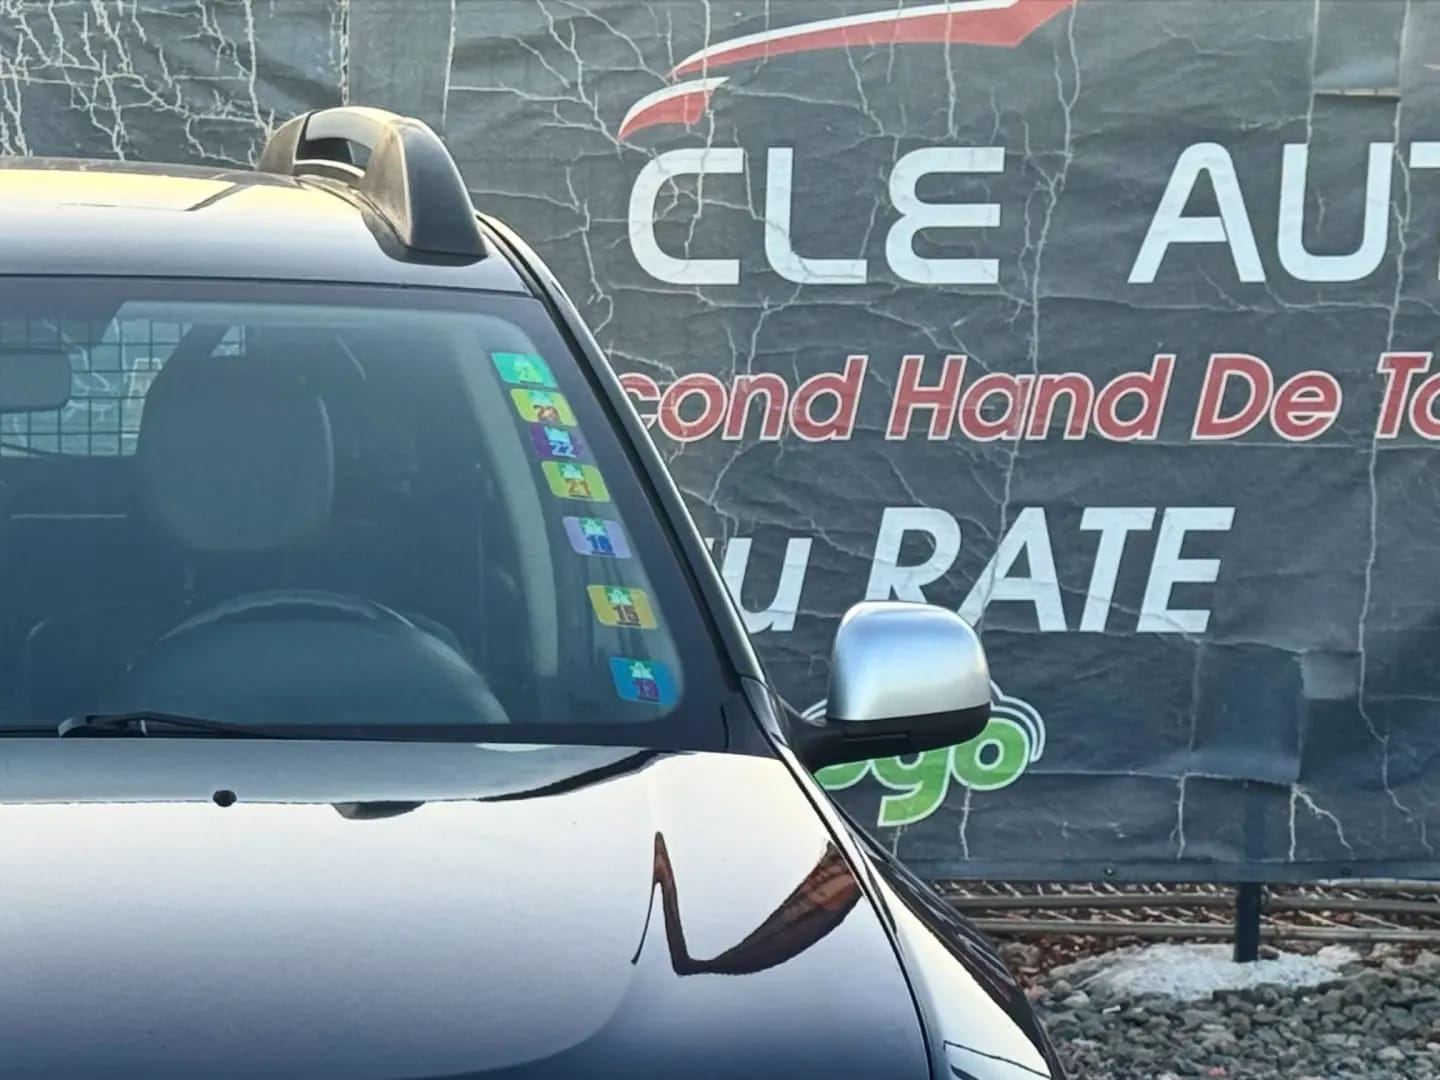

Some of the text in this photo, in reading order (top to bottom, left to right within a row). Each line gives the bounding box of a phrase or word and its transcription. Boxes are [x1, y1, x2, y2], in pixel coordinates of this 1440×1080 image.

[628, 146, 1006, 285] CLE
[885, 354, 1177, 443] Hand
[1191, 353, 1343, 442] De
[864, 506, 1234, 633] RATE
